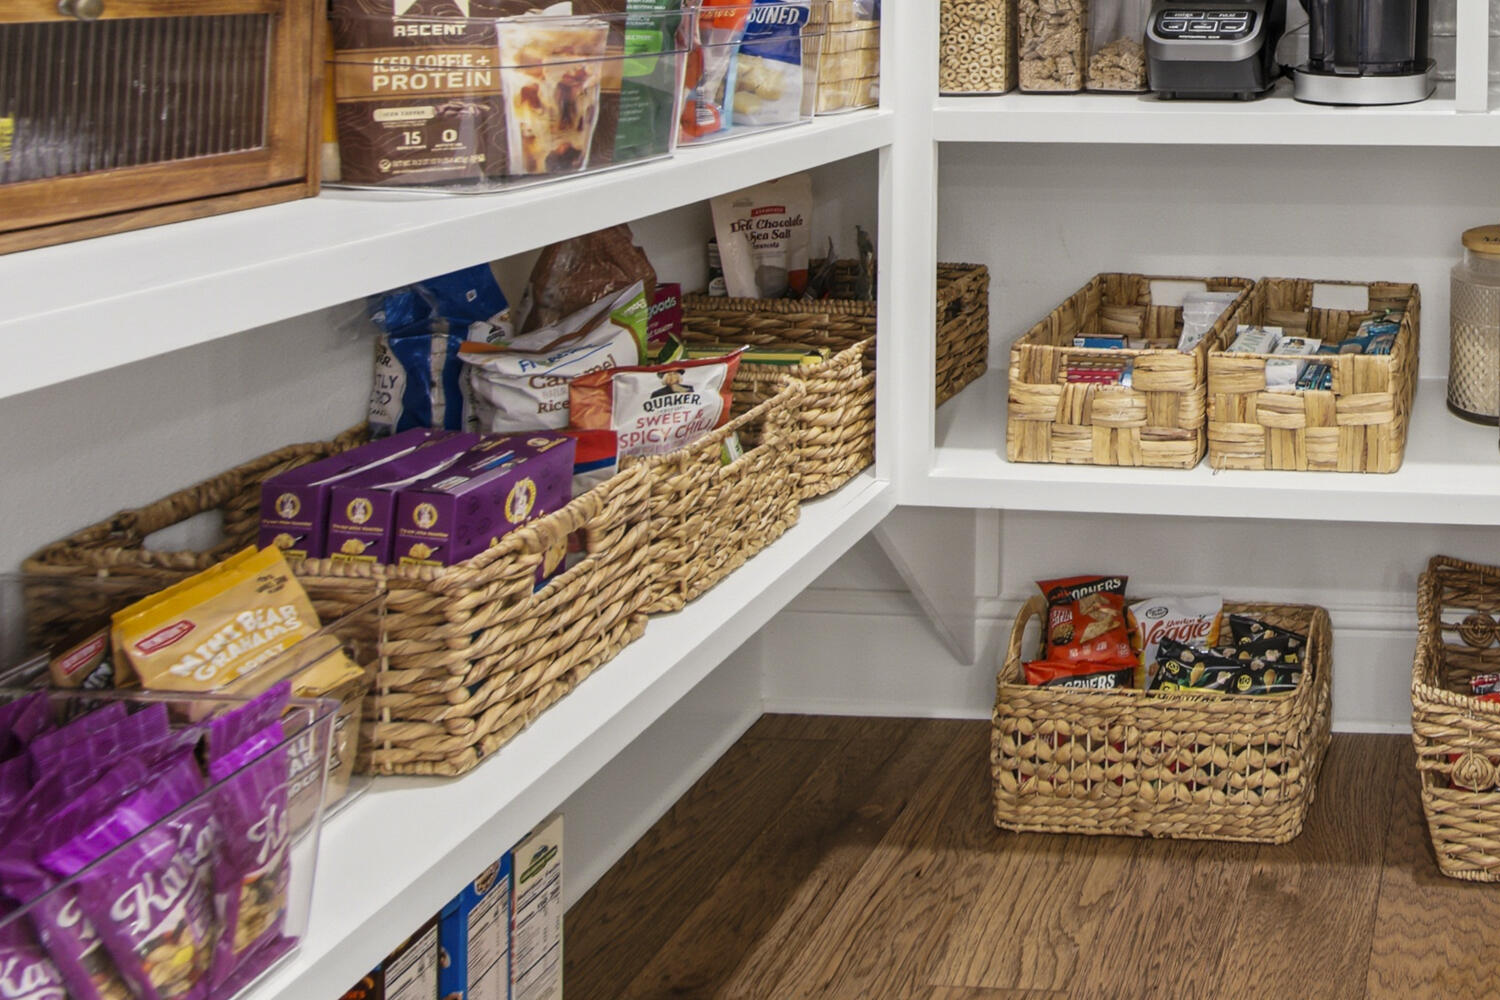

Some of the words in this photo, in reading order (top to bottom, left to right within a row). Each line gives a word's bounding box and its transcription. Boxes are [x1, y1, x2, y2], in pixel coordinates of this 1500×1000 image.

[393, 23, 467, 37] ASCENT
[372, 55, 411, 74] ICED
[415, 53, 474, 72] COFFEE
[371, 70, 492, 92] PROTEIN
[402, 130, 422, 146] 15
[442, 128, 458, 143] 0
[755, 213, 804, 230] Chocolate
[749, 230, 769, 242] Sea
[771, 229, 792, 240] Salt
[528, 353, 618, 391] Carmel
[537, 399, 570, 415] Rice
[643, 393, 702, 413] QUAKER
[636, 410, 692, 430] SWEET
[619, 427, 673, 450] SPICY
[168, 621, 243, 677] MINI
[236, 604, 299, 631] BEAR
[1139, 618, 1213, 650] Veggie
[193, 617, 303, 682] GRAHAMS
